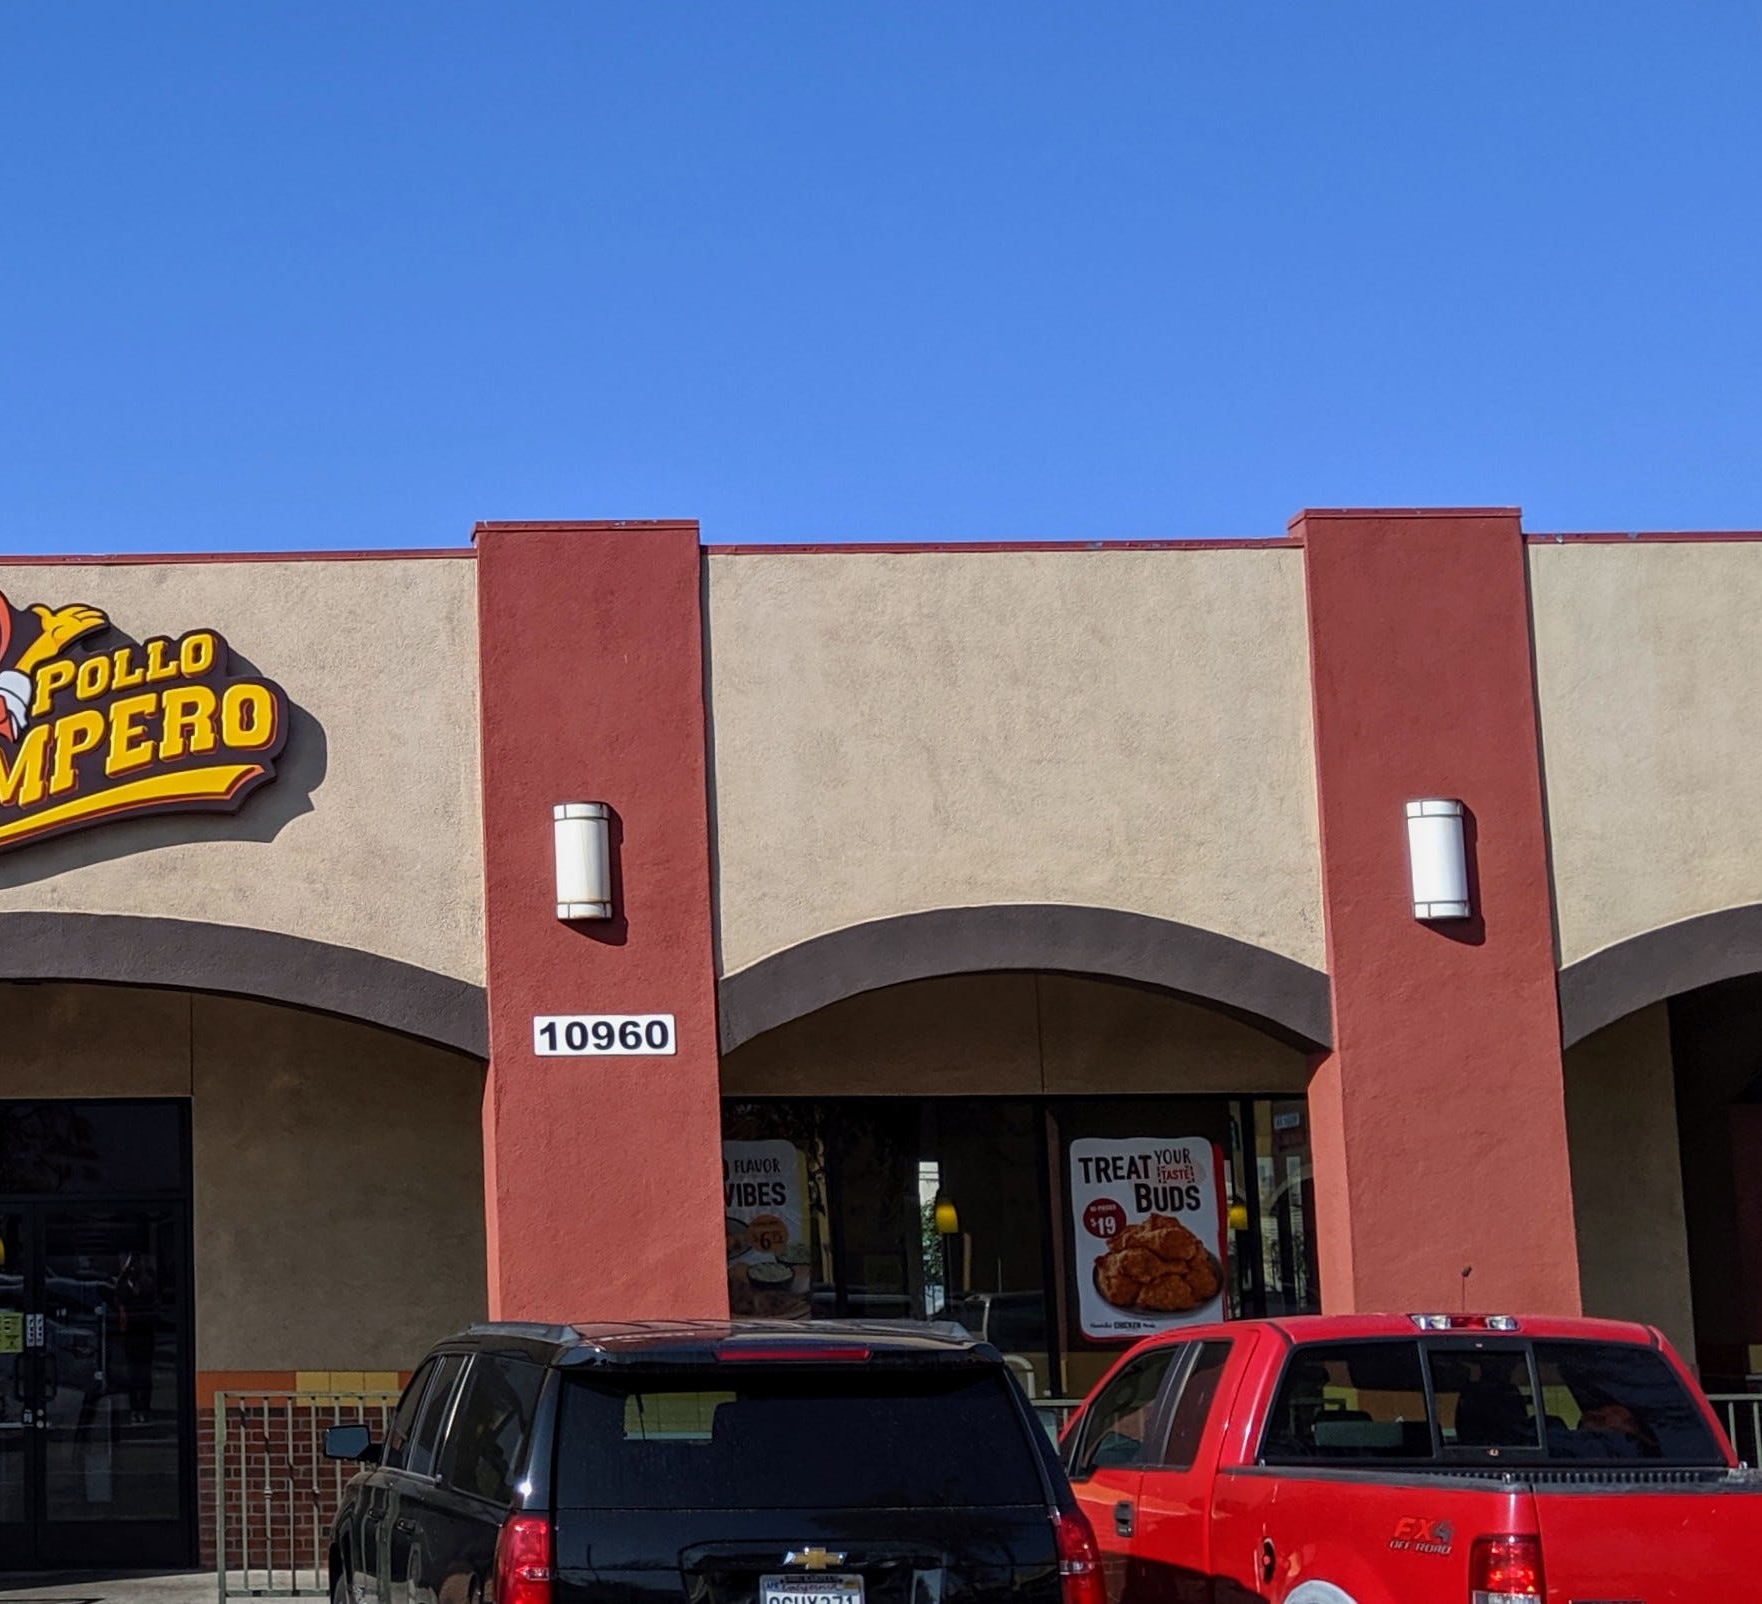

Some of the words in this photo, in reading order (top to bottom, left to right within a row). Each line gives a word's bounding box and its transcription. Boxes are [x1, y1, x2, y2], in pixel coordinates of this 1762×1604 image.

[31, 632, 218, 717] POLLO
[539, 1019, 670, 1051] 10960
[734, 1158, 781, 1174] FLAVOR
[1078, 1155, 1152, 1184] TREAT
[1154, 1148, 1192, 1165] YOUR
[1161, 1169, 1190, 1180] TASTE
[724, 1182, 787, 1208] VIBES
[1134, 1183, 1201, 1213] BUDS
[1090, 1216, 1117, 1235] $19
[1394, 1517, 1454, 1543] FX4
[1389, 1540, 1410, 1550] OFF
[1415, 1542, 1453, 1555] ROAD
